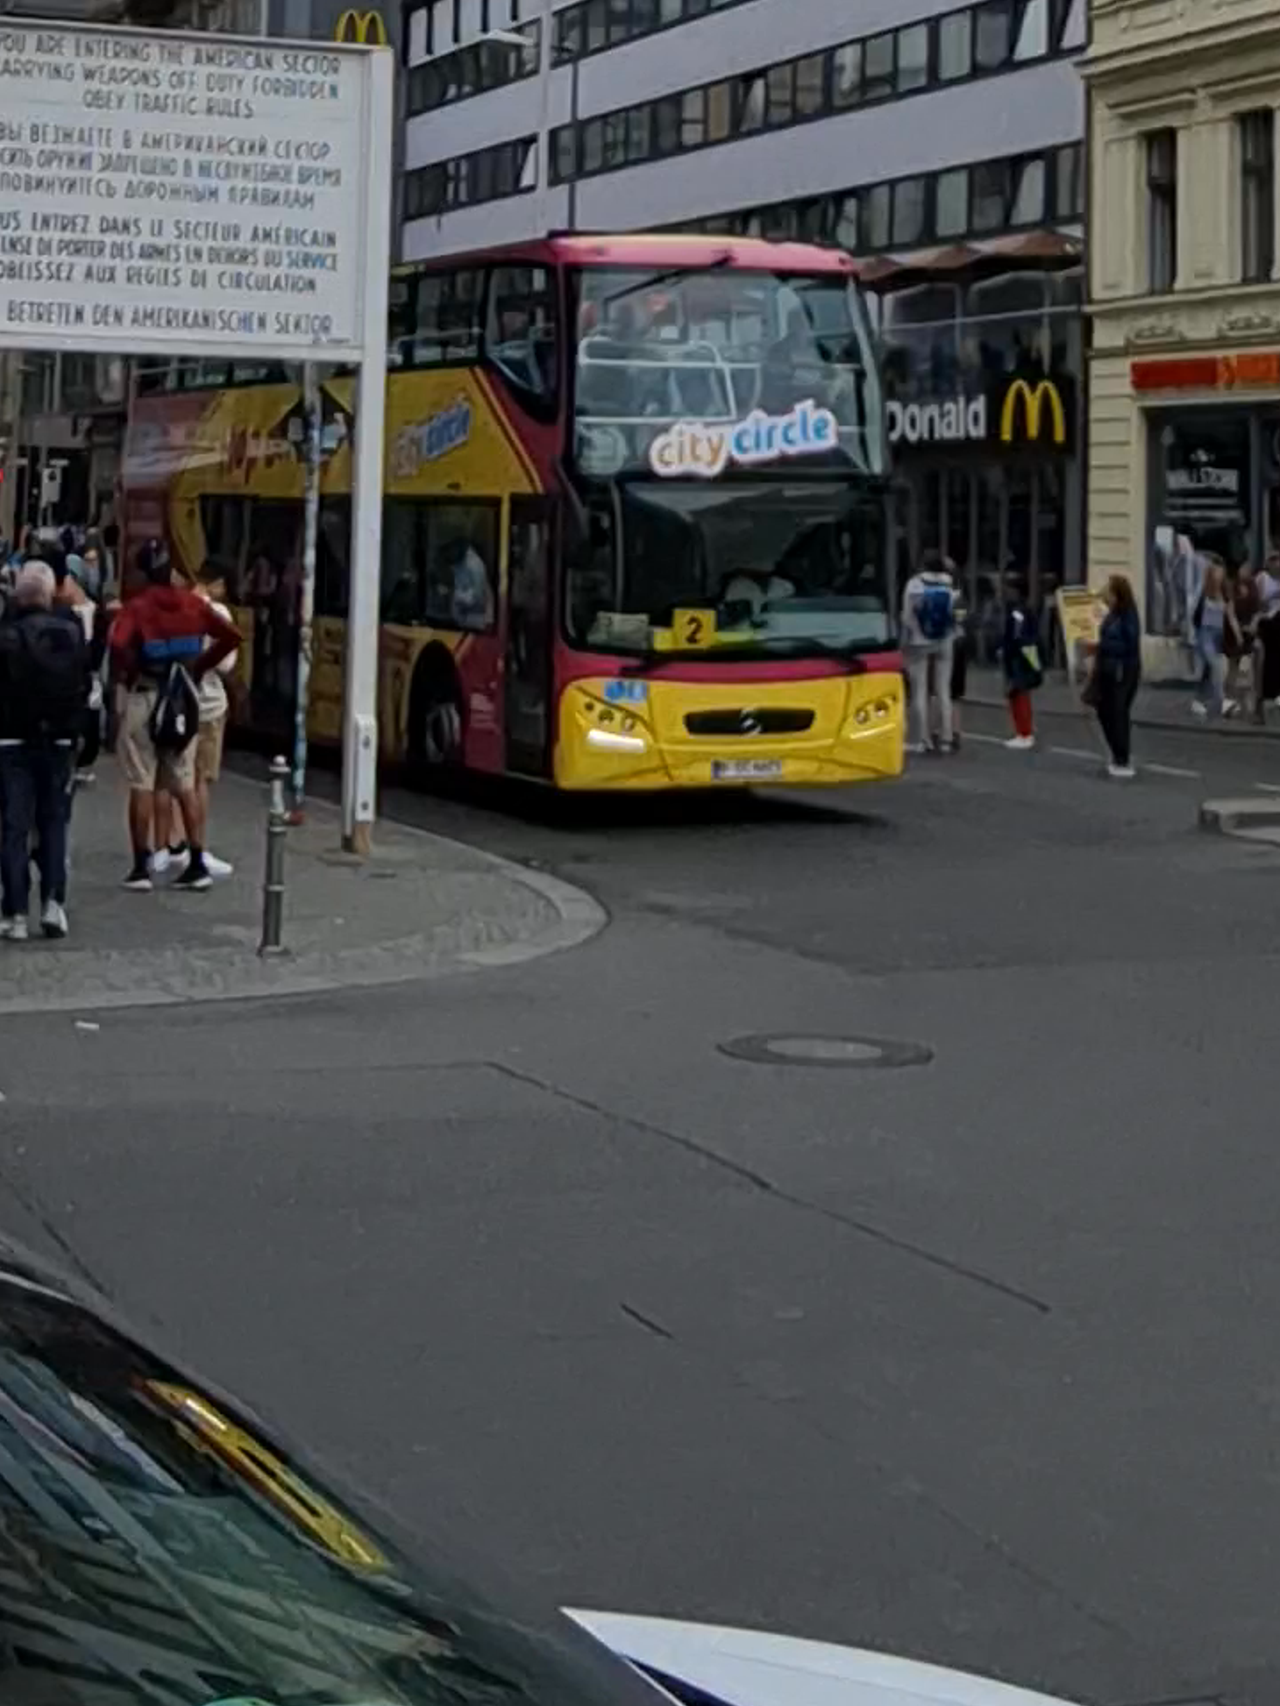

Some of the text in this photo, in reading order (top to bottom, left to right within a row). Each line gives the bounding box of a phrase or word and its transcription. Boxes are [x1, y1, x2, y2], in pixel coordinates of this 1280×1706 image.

[35, 34, 65, 56] ARE
[75, 36, 151, 62] ENTERING
[158, 43, 184, 65] THE
[193, 46, 274, 71] AMERICAN
[282, 53, 342, 76] SECTOR
[82, 63, 161, 88] WEAPONS
[168, 70, 196, 90] OFF
[206, 72, 246, 94] DUTY
[252, 75, 339, 99] FORBIDDEN
[83, 89, 255, 119] OBEY TRAFFIC RULES
[123, 129, 133, 149] В
[273, 139, 331, 161] СЕКТОР
[227, 185, 315, 210] ПРАВИЛАМ
[32, 212, 91, 234] ENTREZ
[99, 215, 143, 237] DANS
[150, 219, 164, 238] LE
[173, 219, 241, 242] SECTEUR
[250, 221, 337, 248] AMÉRICAIN
[37, 237, 52, 256] DE
[57, 238, 106, 258] PORTER
[110, 241, 134, 260] DES
[139, 243, 181, 263] ARMES
[185, 245, 203, 264] EN
[207, 246, 259, 267] DEHORS
[264, 250, 282, 268] DU
[286, 251, 338, 272] SERVICE
[83, 264, 117, 284] AUX
[190, 269, 207, 289] DE
[217, 270, 317, 294] CIRCULATION
[6, 299, 85, 325] BETRETEN
[92, 302, 125, 326] DEN
[130, 304, 267, 334] AMERIKANISCHEN
[274, 311, 333, 335] SEKTOR
[655, 407, 837, 474] city circle
[684, 614, 704, 646] 2
